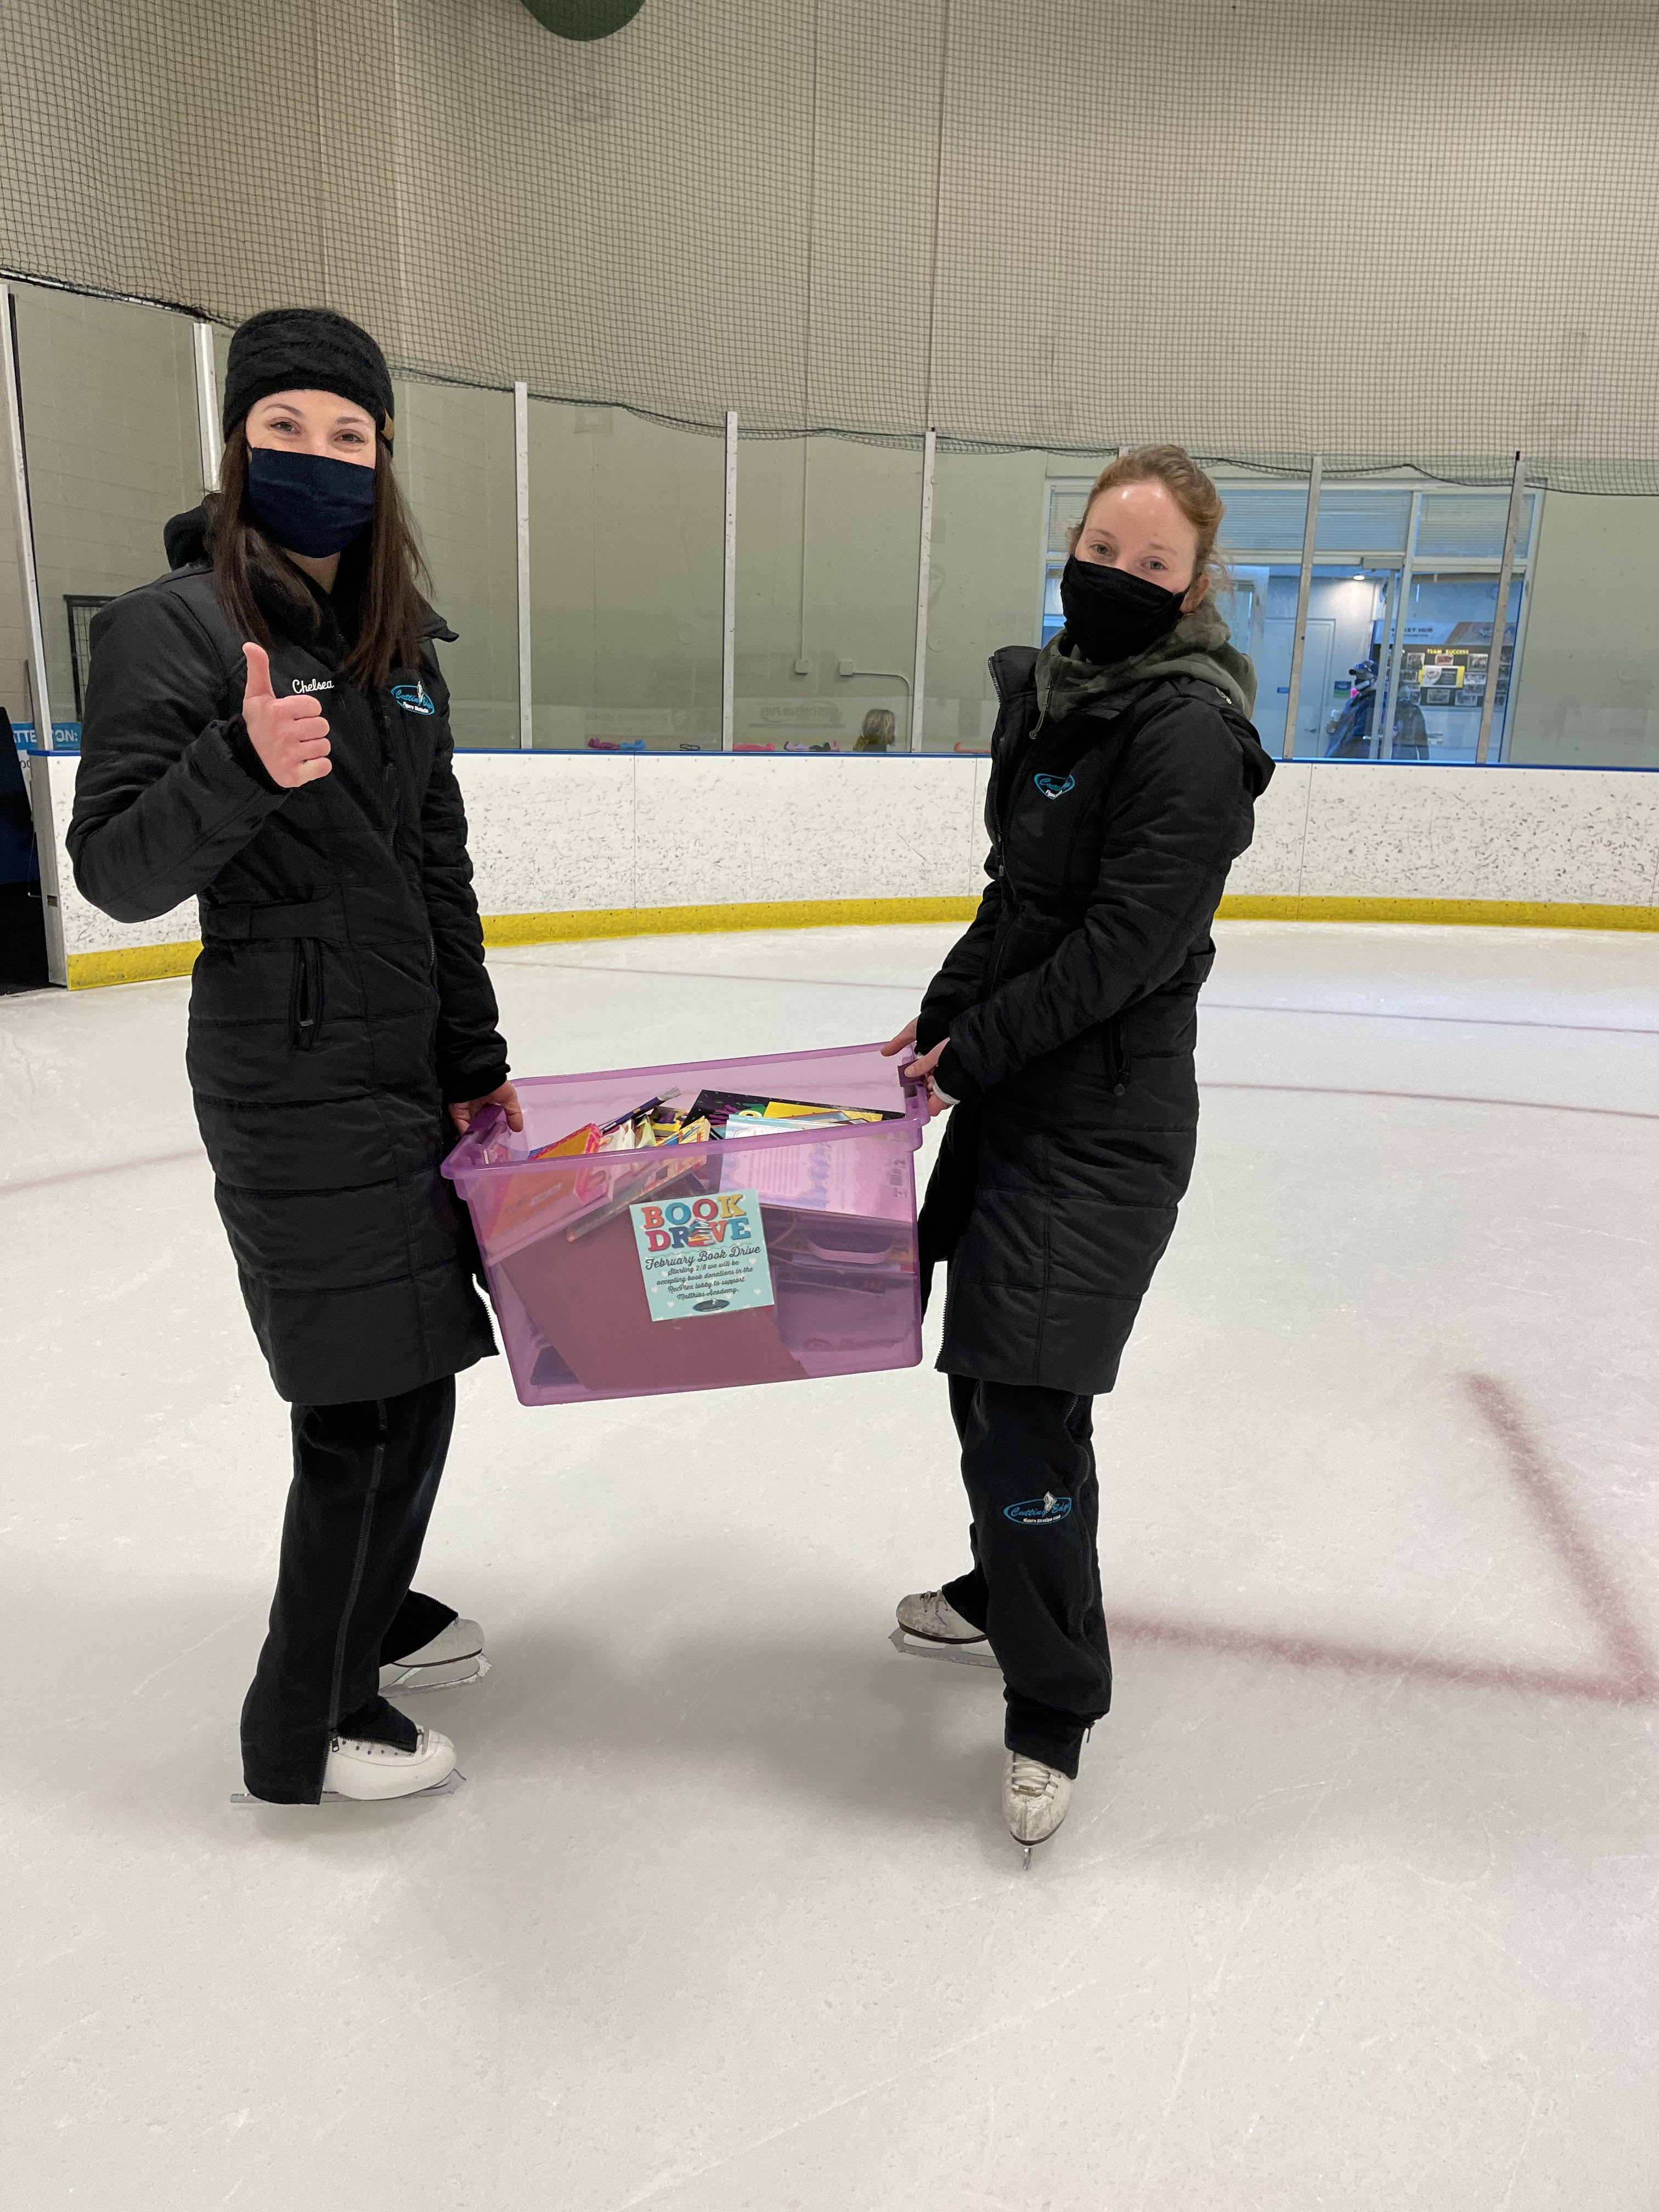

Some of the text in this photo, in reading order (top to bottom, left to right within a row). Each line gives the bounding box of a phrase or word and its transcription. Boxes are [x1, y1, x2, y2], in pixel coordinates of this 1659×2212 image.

[292, 679, 334, 694] Chelsea
[641, 1194, 747, 1230] BOOK
[645, 1217, 751, 1252] DRVE
[645, 1246, 761, 1270] February Book Drive
[657, 1277, 686, 1285] accepting
[704, 1269, 735, 1279] donations
[668, 1266, 694, 1276] Starting
[721, 1276, 746, 1285] support
